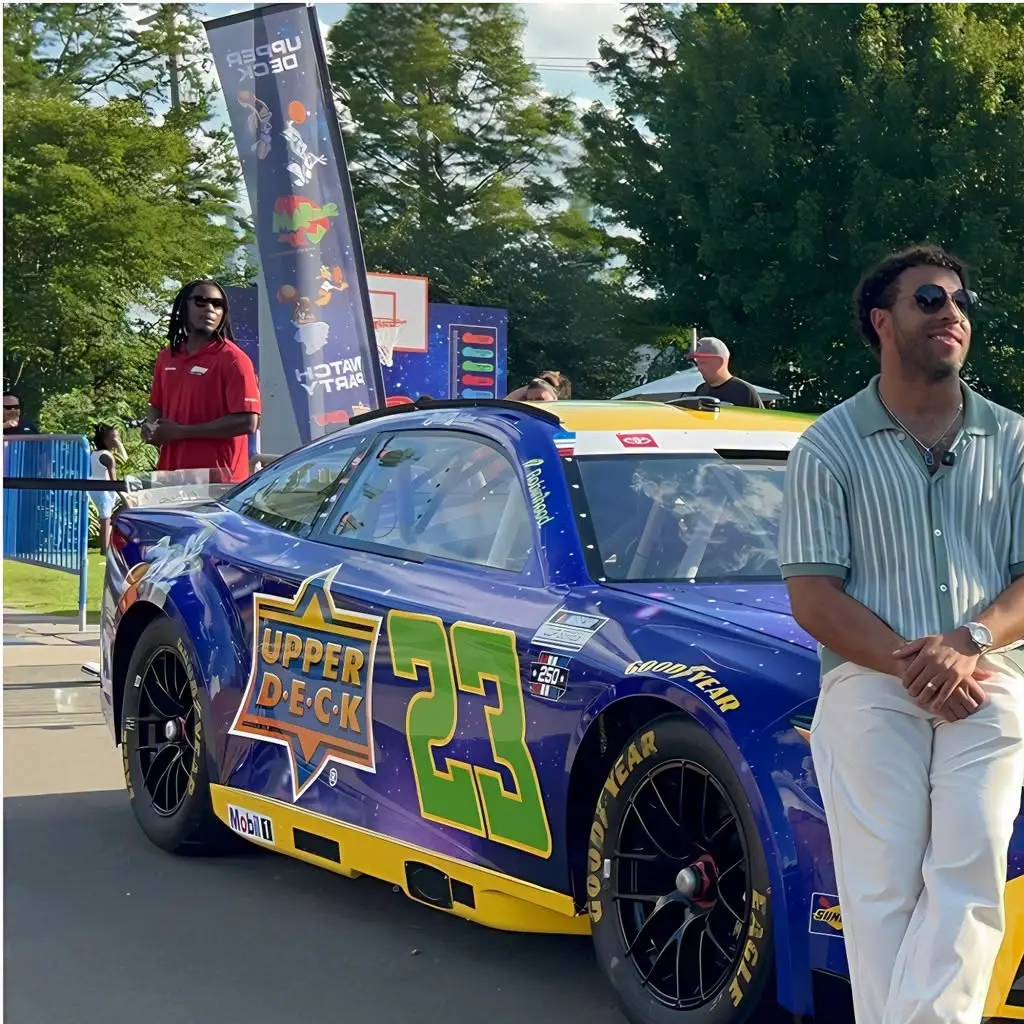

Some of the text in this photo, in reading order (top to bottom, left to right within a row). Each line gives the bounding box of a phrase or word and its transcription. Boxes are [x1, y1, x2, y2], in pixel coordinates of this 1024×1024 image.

[261, 628, 364, 686] UPPER
[537, 665, 561, 685] 250
[624, 660, 741, 714] GOODYEAR
[387, 609, 552, 859] 23
[229, 807, 261, 838] Mobil
[813, 909, 842, 922] SUN
[728, 889, 767, 1008] EAGLE
